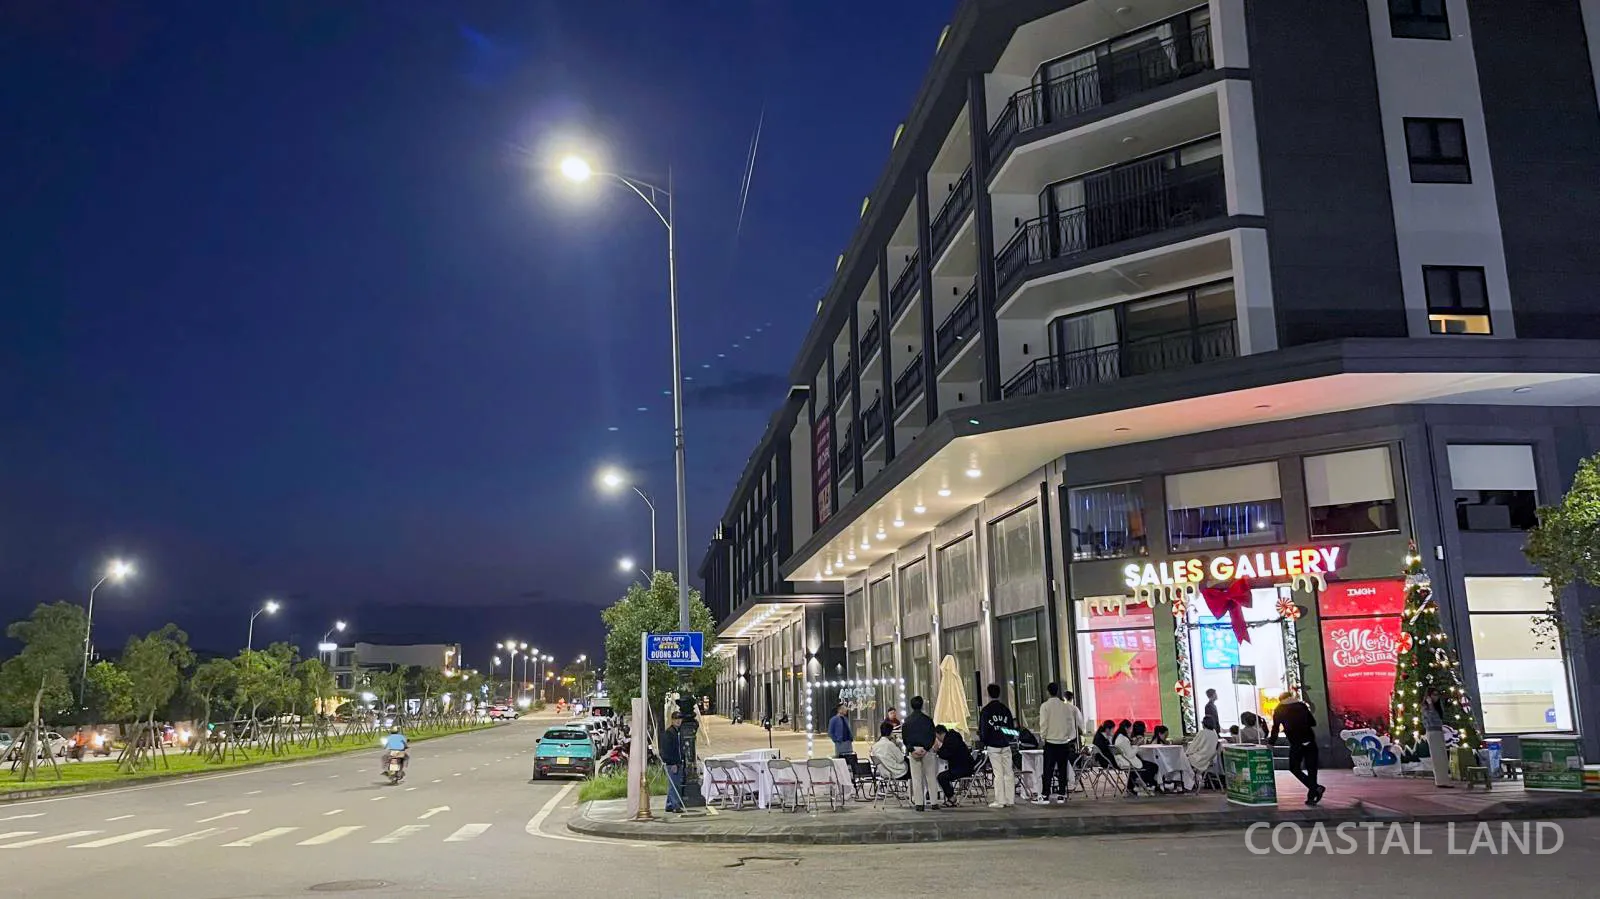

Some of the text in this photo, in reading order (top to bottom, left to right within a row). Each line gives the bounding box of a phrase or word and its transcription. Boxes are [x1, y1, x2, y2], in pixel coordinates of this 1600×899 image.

[1123, 546, 1340, 588] SALES GALLERY
[1335, 627, 1396, 653] Merry
